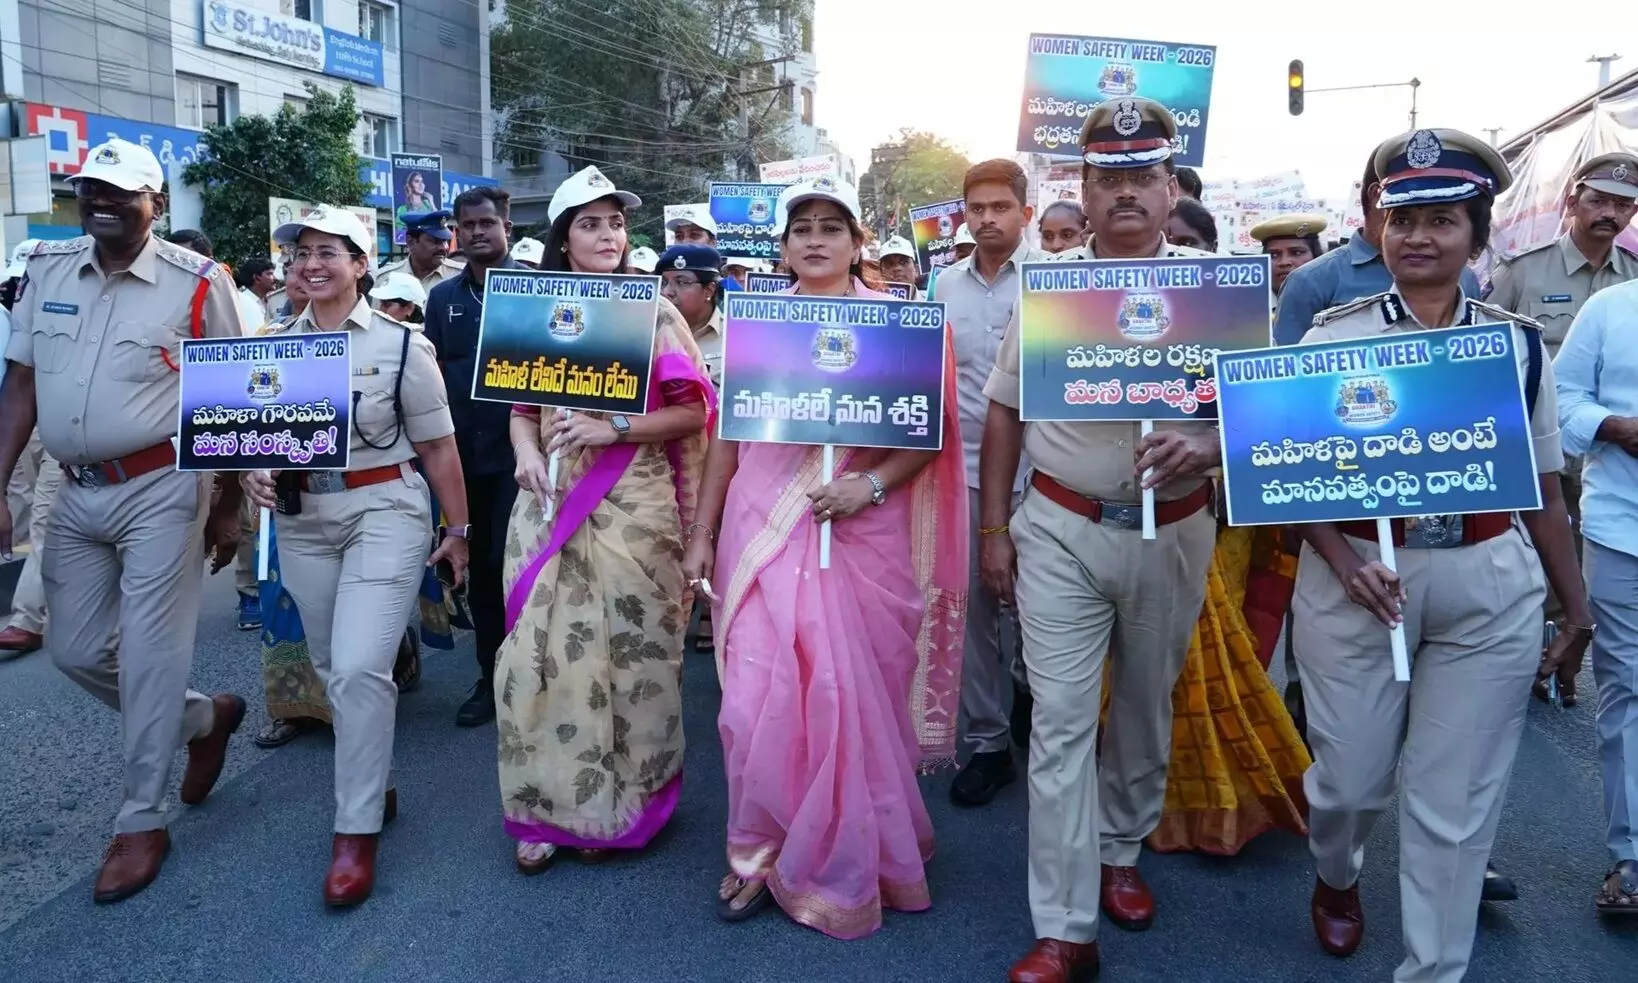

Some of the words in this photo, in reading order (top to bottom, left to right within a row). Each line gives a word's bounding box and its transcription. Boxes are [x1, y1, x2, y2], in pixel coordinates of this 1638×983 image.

[1031, 37, 1080, 57] WOMEN
[1082, 40, 1128, 60] SAFETY
[1131, 43, 1165, 62] WEEK
[1178, 48, 1212, 67] 2026
[713, 186, 739, 196] WOMEN
[740, 186, 765, 197] SAFETY
[492, 276, 534, 295] WOMEN
[536, 277, 577, 297] SAFETY
[580, 280, 611, 298] WEEK
[621, 282, 653, 301] 2026
[1028, 269, 1089, 290] WOMEN
[1093, 267, 1152, 289] SAFETY
[1155, 265, 1201, 287] WEEK
[1216, 263, 1264, 287] 2026
[731, 299, 787, 320] WOMEN
[792, 301, 843, 323] SAFETY
[847, 305, 888, 325] WEEK
[901, 306, 941, 327] 2026
[187, 345, 229, 363] WOMEN
[232, 343, 273, 362] SAFETY
[274, 341, 304, 360] WEEK
[314, 340, 345, 358] 2026
[1065, 343, 1162, 369] మహిళల
[1166, 344, 1217, 378] రక్షణ
[1224, 355, 1296, 384] WOMEN
[1301, 348, 1370, 377] SAFETY
[1375, 341, 1431, 369] WEEK
[1448, 333, 1507, 361] 2026
[484, 357, 531, 390] మహిళ
[530, 355, 568, 394] లేనిదే
[566, 364, 604, 397] మనం
[603, 360, 640, 401] లేము
[1064, 377, 1124, 405] మన
[1126, 377, 1217, 414] బాధ్యత
[192, 404, 259, 425] మహిళా
[261, 397, 337, 424] గౌరవమే
[732, 387, 833, 422] మహిళలే
[834, 394, 883, 425] మన
[886, 394, 929, 437] శక్తి
[192, 430, 239, 457] మన
[240, 425, 338, 464] సంస్కృతి!
[1250, 433, 1360, 470] మహిళపై
[1363, 427, 1423, 458] దాడి
[1427, 416, 1498, 453] అంటే
[1261, 470, 1423, 509] మానవత్వంపై
[1425, 460, 1498, 496] దాడి!
